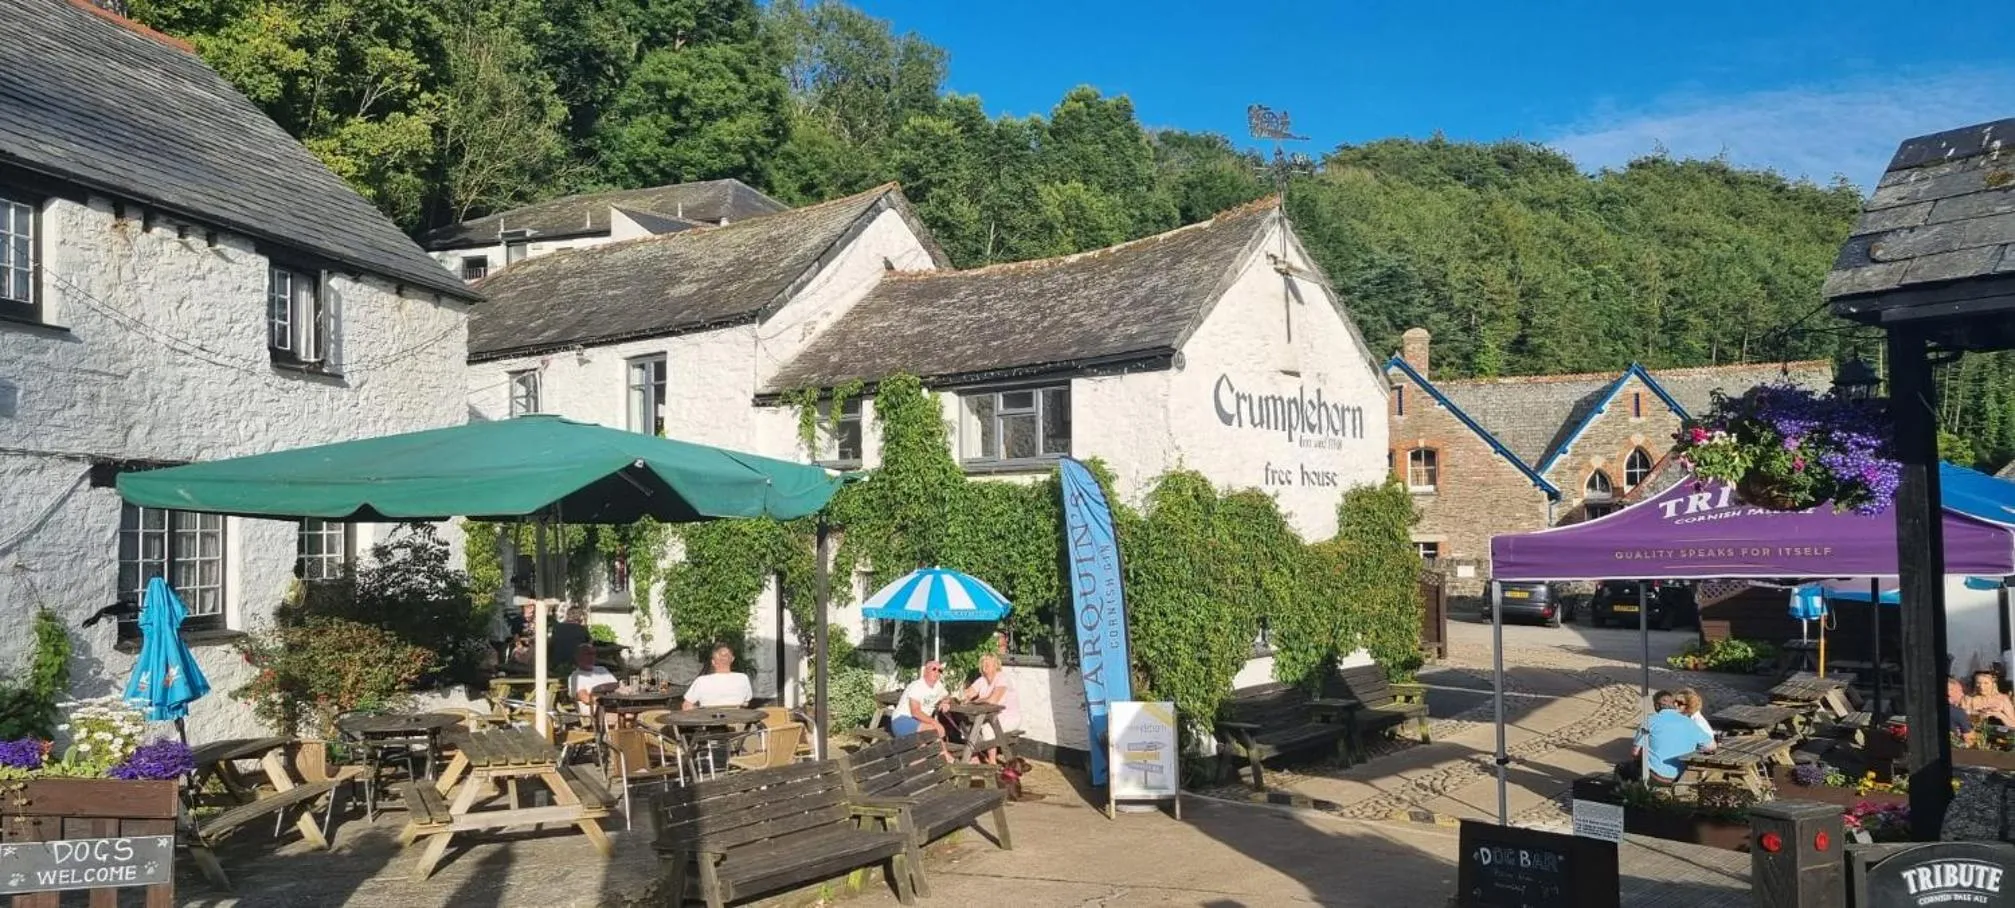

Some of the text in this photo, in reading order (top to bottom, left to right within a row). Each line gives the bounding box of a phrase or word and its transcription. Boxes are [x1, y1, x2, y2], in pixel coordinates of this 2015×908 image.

[1214, 373, 1364, 442] Crumplehorn
[1265, 461, 1338, 488] free house
[1674, 511, 1741, 525] CORNISH
[1615, 547, 1833, 560] QUALITY SPEAKS FOR ITSELF
[1105, 578, 1120, 648] CORNISH
[53, 838, 134, 864] DOGS
[1480, 847, 1559, 873] DOG BAR
[36, 865, 137, 886] WELCOME
[1902, 863, 2003, 894] TRIBUTE
[1973, 895, 1988, 904] ALE
